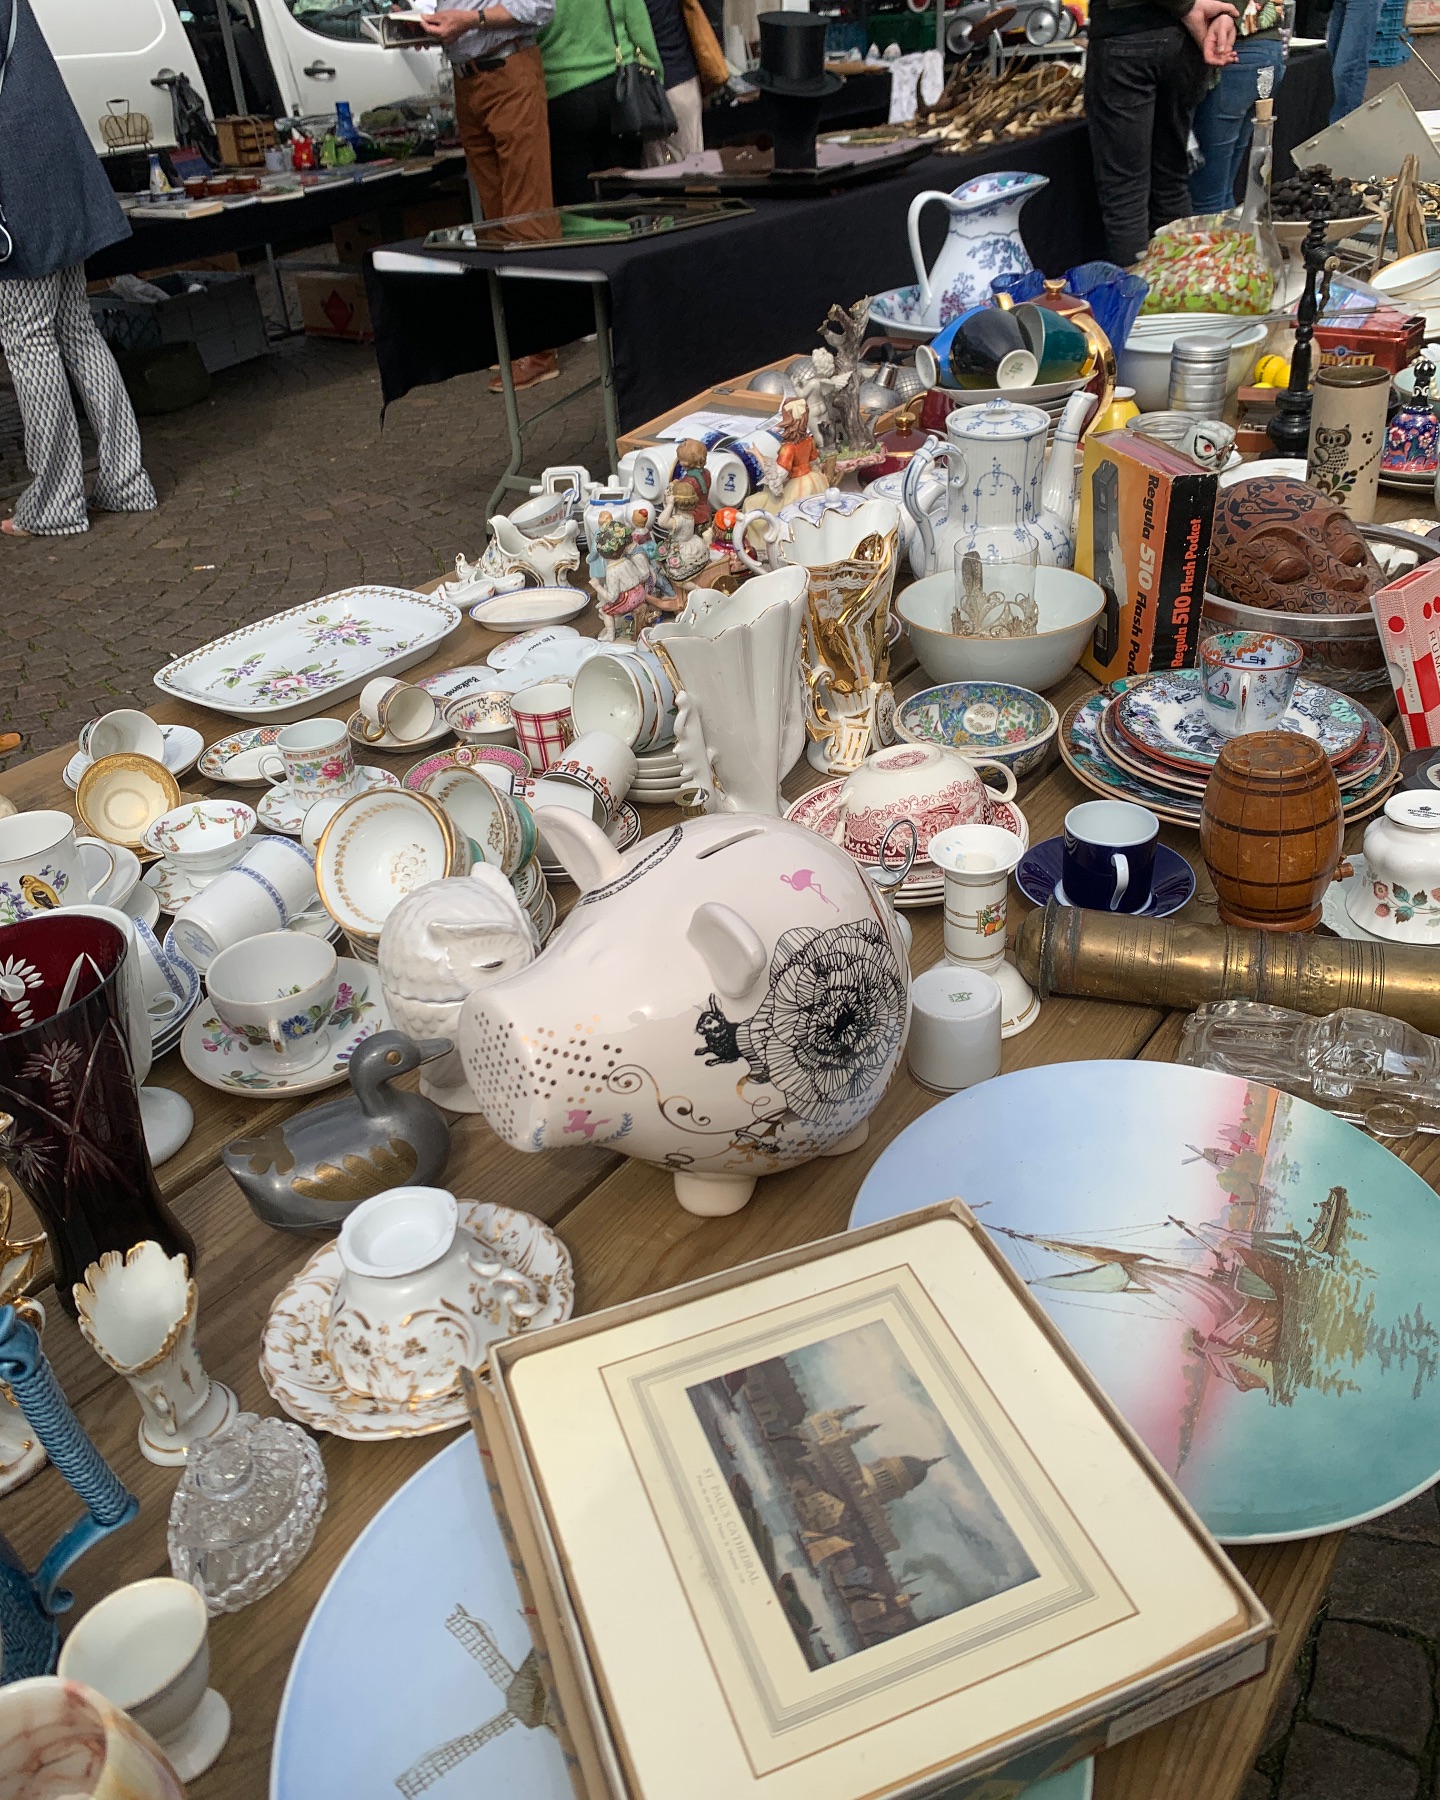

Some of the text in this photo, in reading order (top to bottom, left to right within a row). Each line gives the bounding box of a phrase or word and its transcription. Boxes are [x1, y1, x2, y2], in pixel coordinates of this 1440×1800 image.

[1140, 474, 1159, 540] Regula
[1137, 543, 1156, 591] 510
[1170, 518, 1202, 667] Regula 510 Flash Pocket
[1131, 591, 1147, 637] Flash
[726, 1520, 760, 1586] CATHEDRAL
